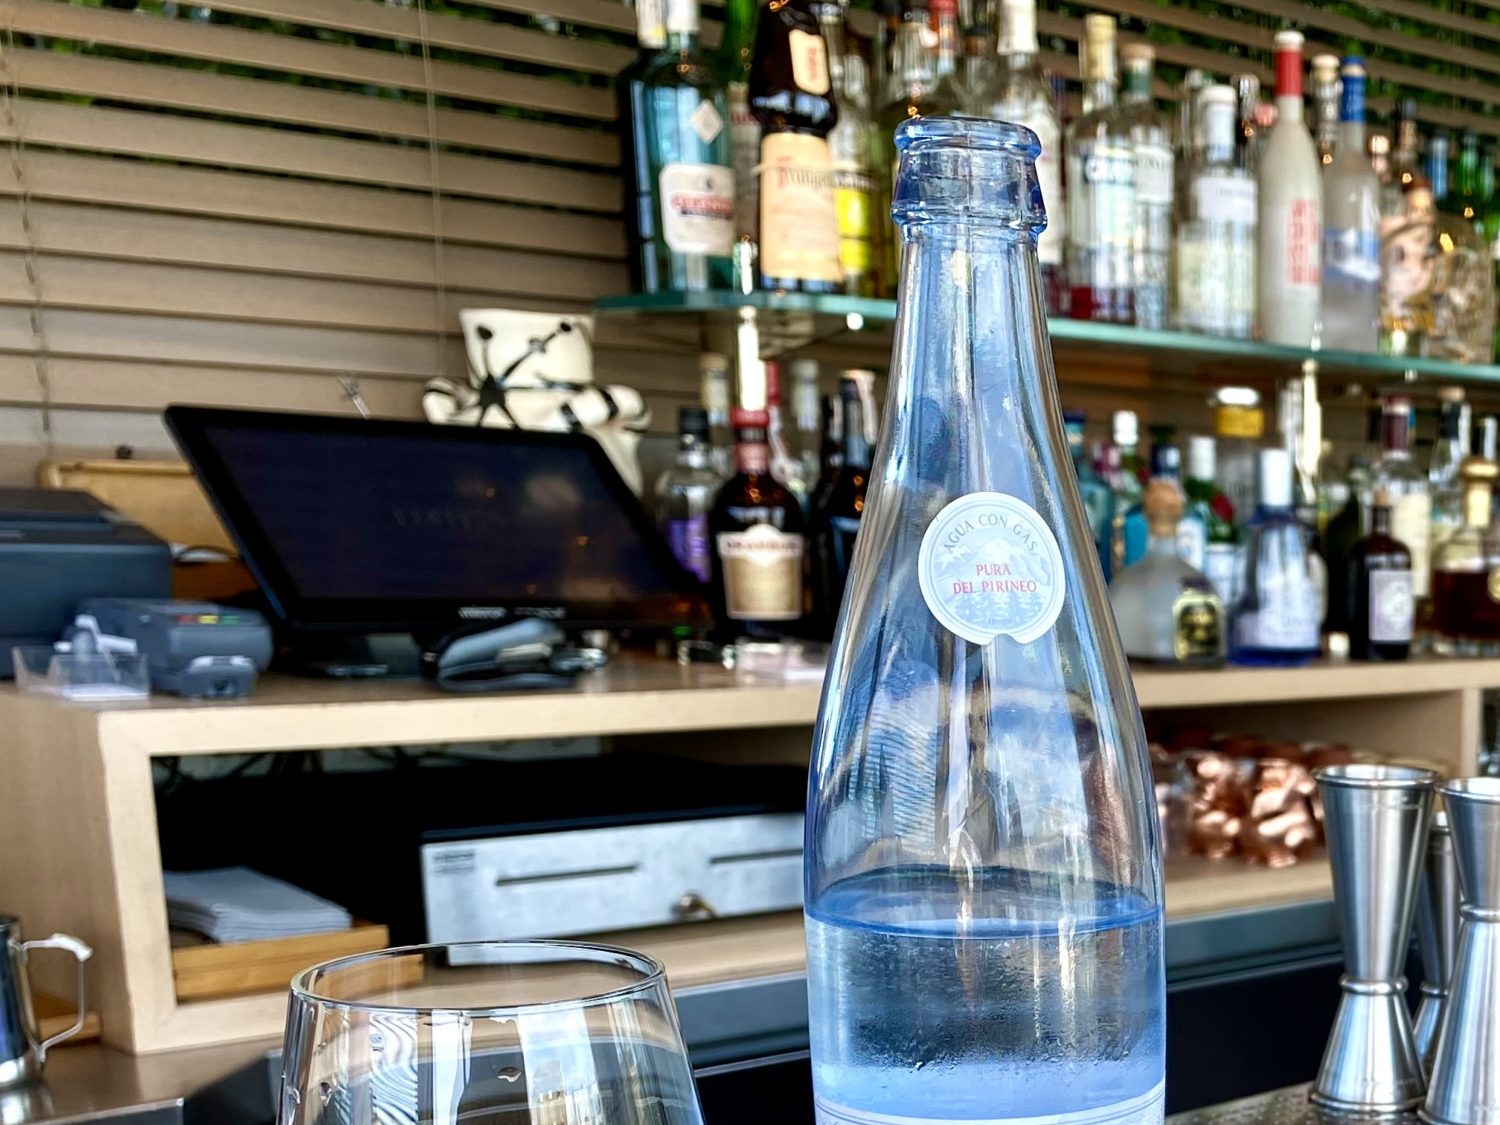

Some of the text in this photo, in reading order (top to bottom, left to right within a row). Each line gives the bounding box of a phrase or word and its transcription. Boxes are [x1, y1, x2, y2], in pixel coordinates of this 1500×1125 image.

[943, 513, 1039, 554] AGUA CON GAS
[976, 563, 1012, 576] PURA
[953, 580, 1037, 595] DEL PIRINEO
